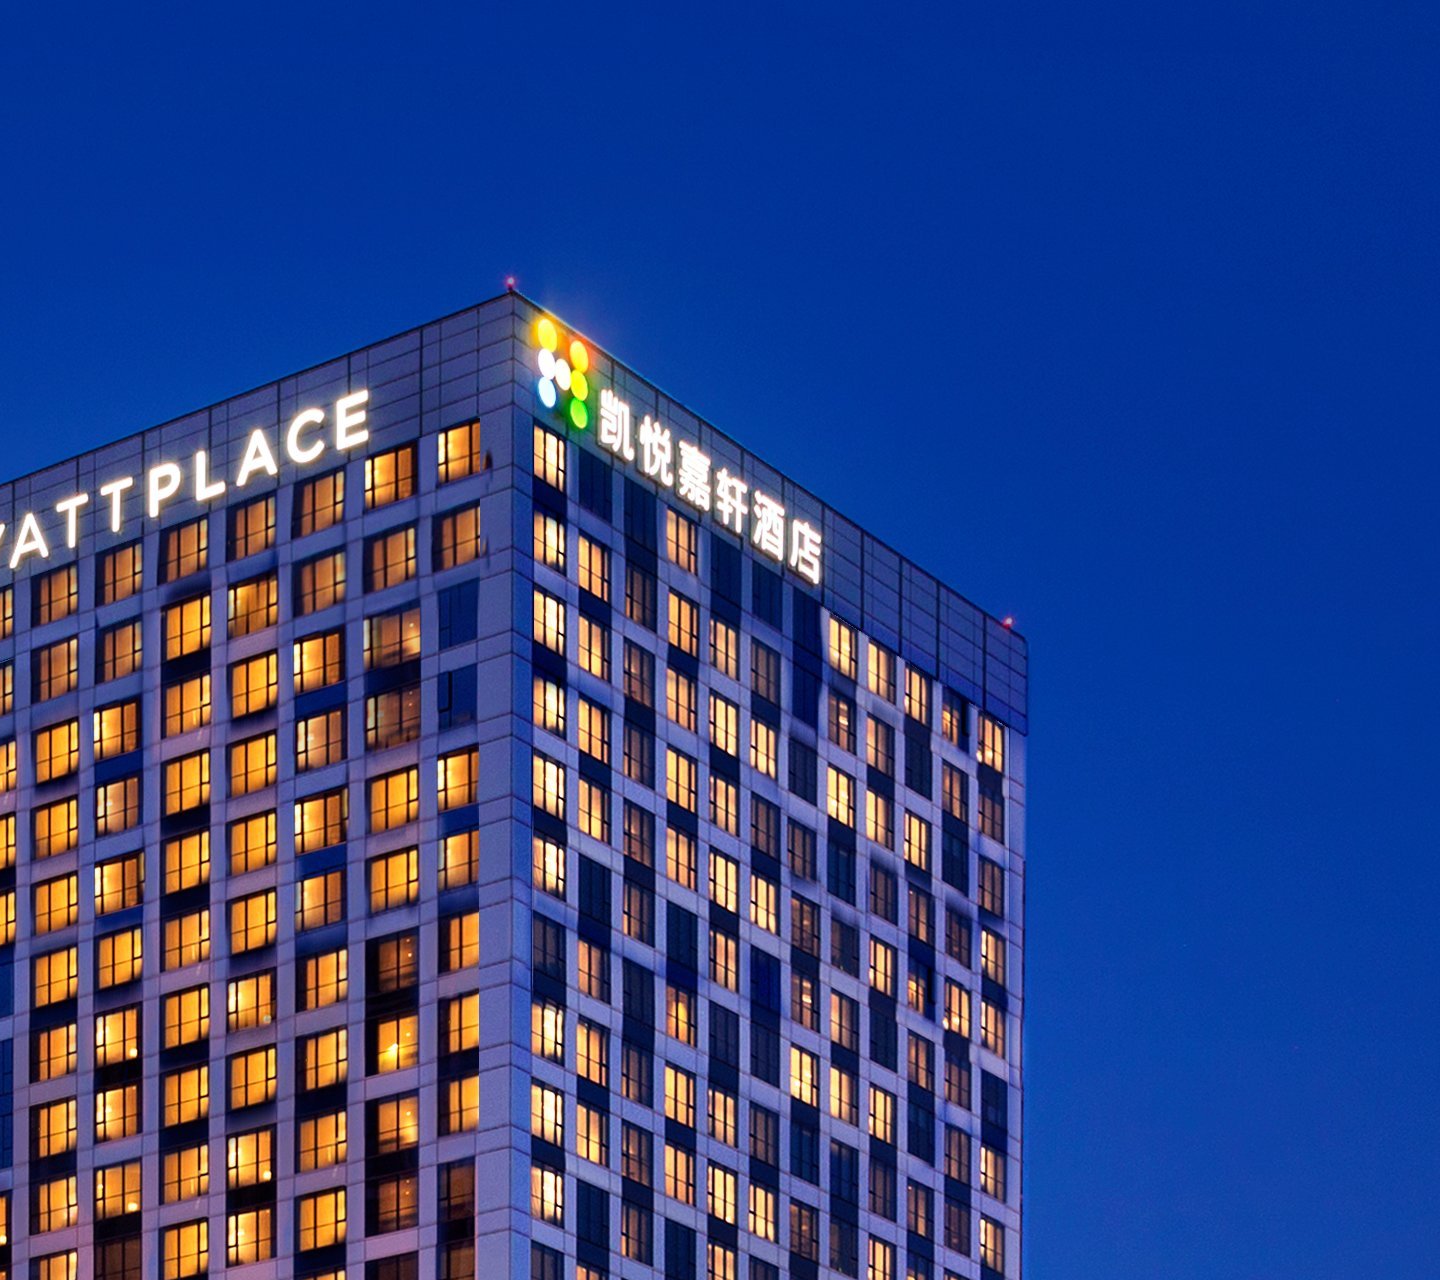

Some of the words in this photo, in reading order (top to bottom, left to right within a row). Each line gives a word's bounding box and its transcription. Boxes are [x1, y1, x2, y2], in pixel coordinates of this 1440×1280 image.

[599, 388, 823, 586] 凯悦嘉轩酒店
